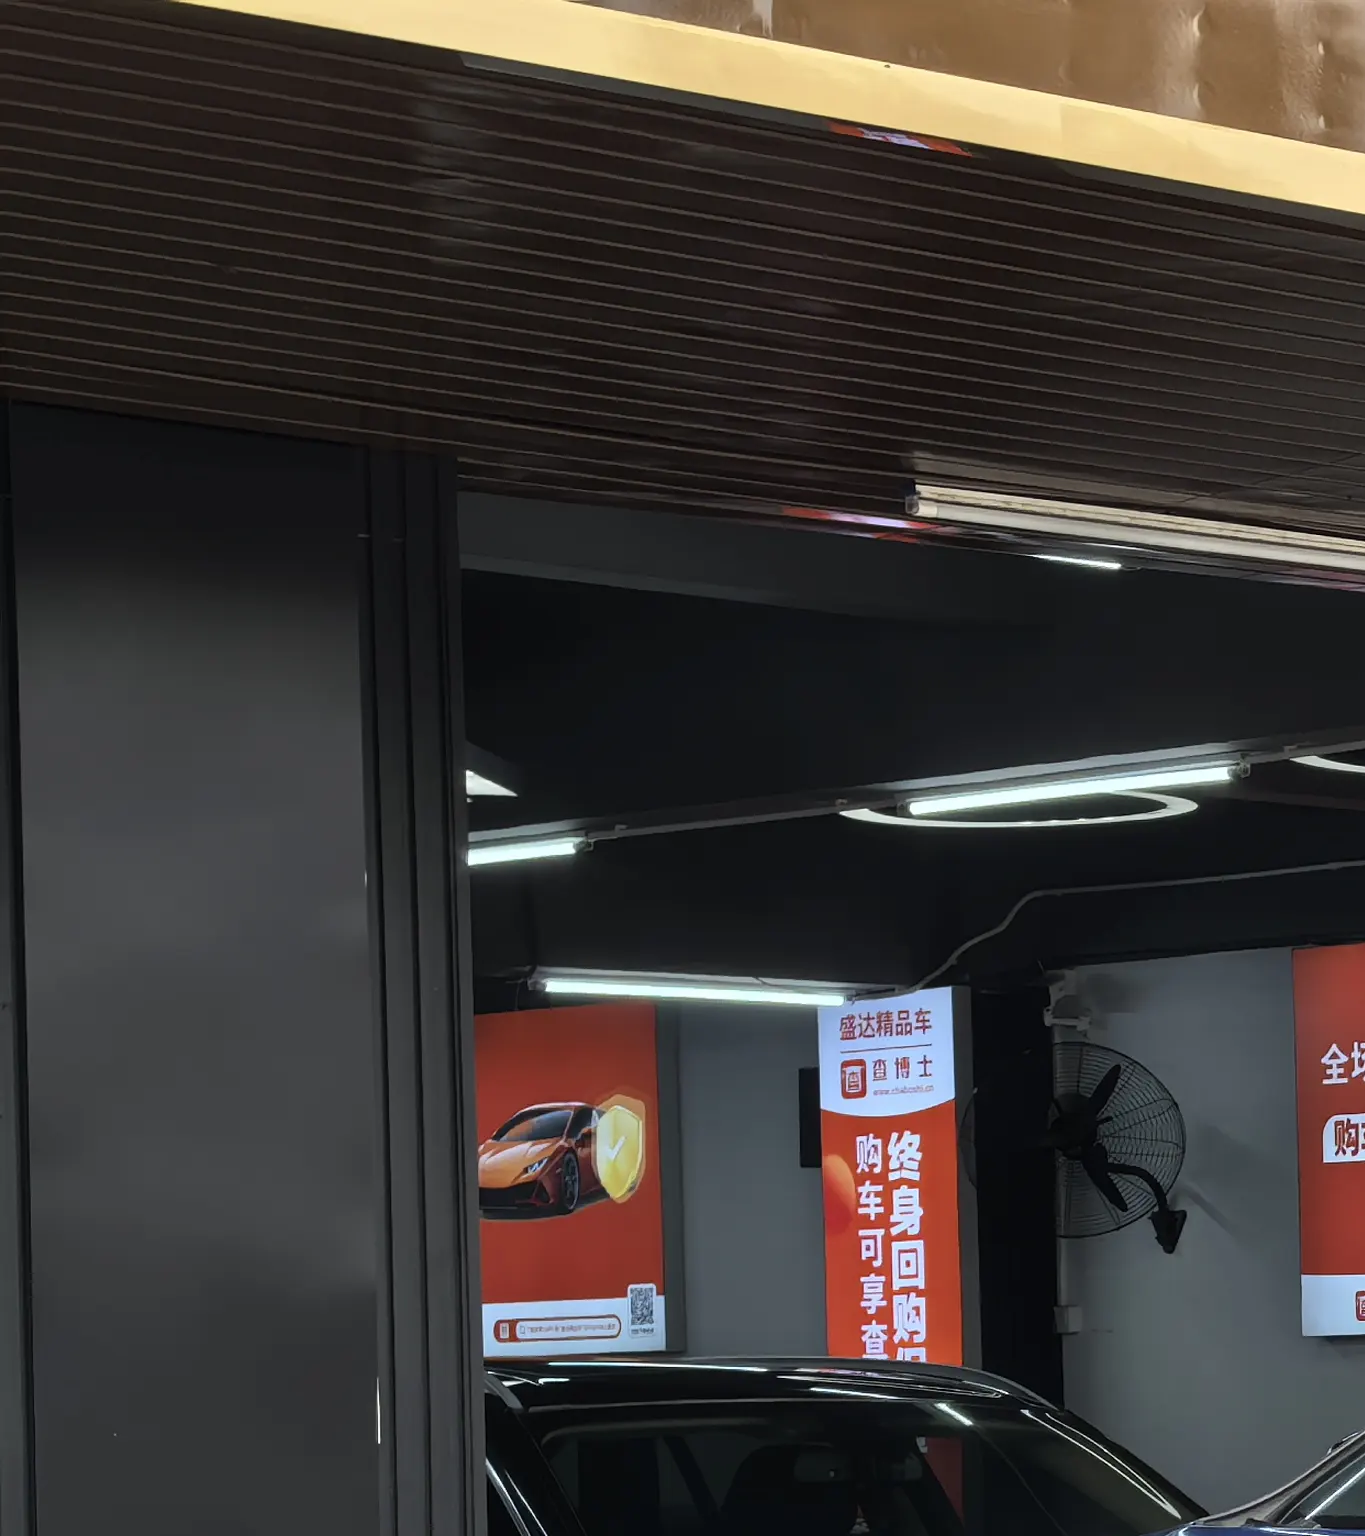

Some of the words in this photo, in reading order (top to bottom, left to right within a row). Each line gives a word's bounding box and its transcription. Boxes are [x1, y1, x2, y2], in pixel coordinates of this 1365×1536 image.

[840, 1008, 932, 1041] 盛达精品车
[872, 1055, 932, 1081] 查博士
[856, 1134, 888, 1360] 购车可享查
